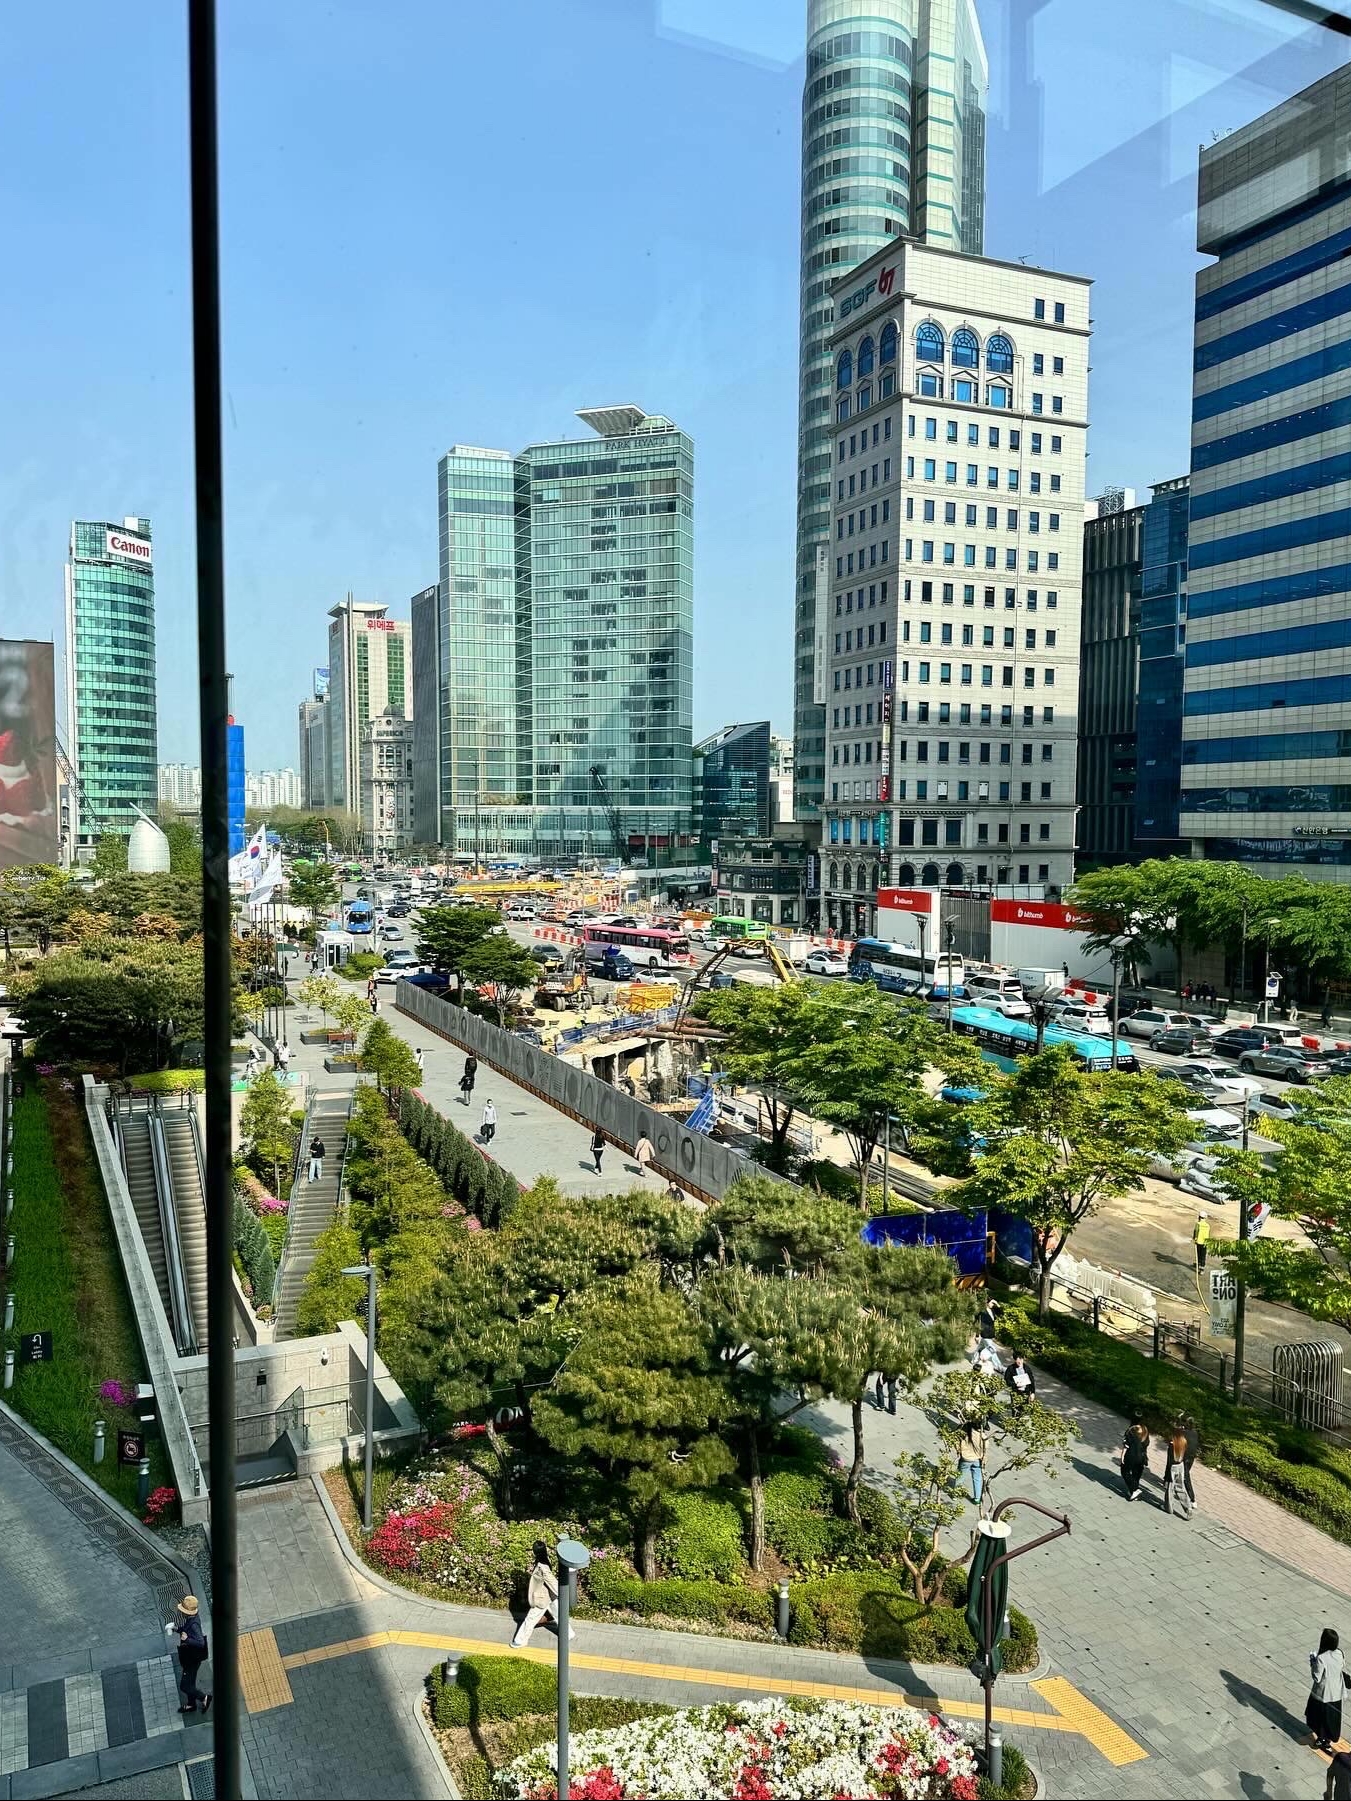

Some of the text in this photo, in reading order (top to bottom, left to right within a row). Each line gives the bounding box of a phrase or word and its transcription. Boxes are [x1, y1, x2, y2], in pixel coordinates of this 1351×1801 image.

[606, 437, 668, 450] PARK HYATT
[111, 536, 150, 558] Canon
[367, 620, 395, 631] 위메프
[1302, 826, 1328, 835] 신한은행
[1023, 911, 1044, 919] bithumb
